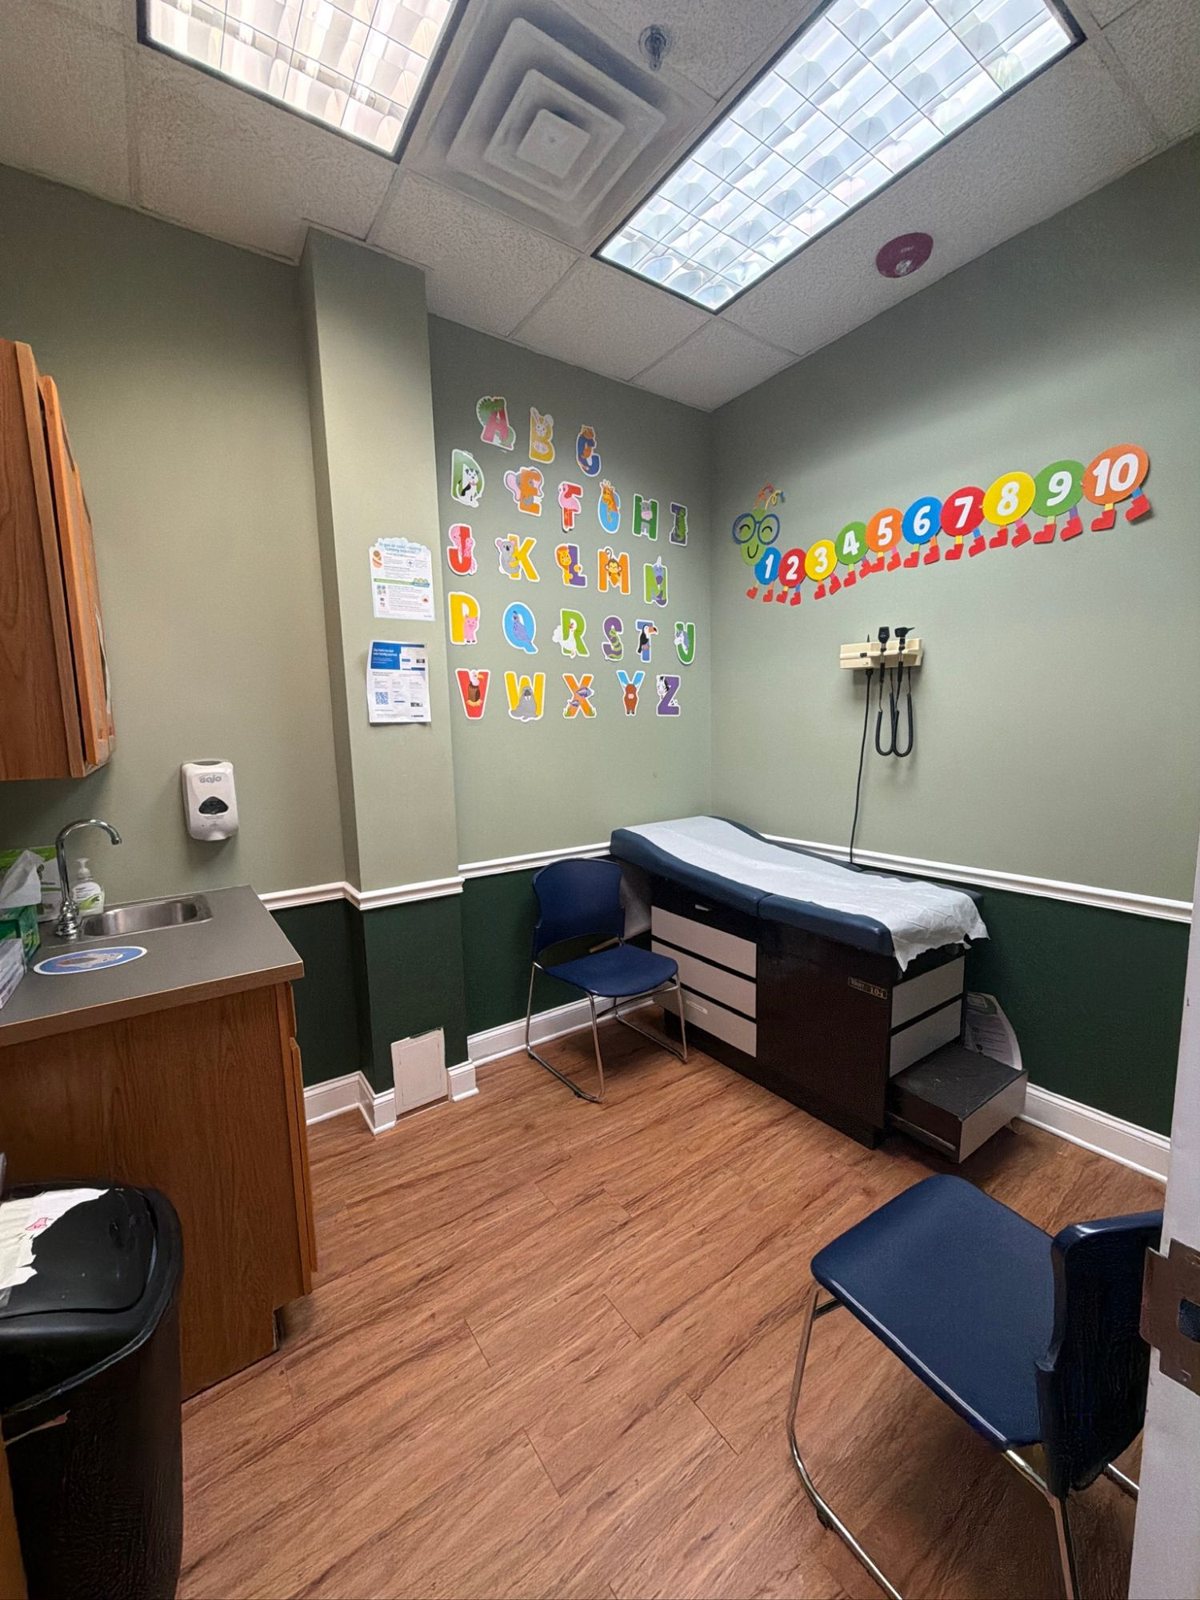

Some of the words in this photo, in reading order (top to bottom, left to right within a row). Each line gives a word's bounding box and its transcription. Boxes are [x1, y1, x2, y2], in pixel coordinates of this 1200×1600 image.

[478, 397, 515, 449] A
[530, 409, 555, 463] B
[576, 427, 601, 476] C
[451, 450, 485, 506] D
[514, 467, 544, 516] E
[559, 482, 583, 532] F
[598, 483, 620, 533] G
[633, 494, 659, 541] H
[670, 502, 688, 546] I
[765, 554, 774, 579] 1
[786, 555, 800, 580] 2
[814, 546, 829, 573] 3
[843, 530, 860, 556] 4
[877, 515, 894, 546] 5
[913, 505, 931, 536] 6
[954, 495, 974, 528] 7
[997, 481, 1020, 516] 8
[1046, 471, 1073, 506] 9
[1092, 453, 1139, 496] 10
[447, 524, 475, 575] J
[499, 534, 540, 582] K
[556, 544, 587, 587] L
[598, 548, 631, 595] M
[644, 560, 668, 607] N
[449, 592, 480, 645] P
[502, 602, 538, 654] Q
[556, 608, 590, 657] R
[602, 615, 624, 660] S
[635, 619, 657, 662] T
[674, 621, 695, 664] U
[455, 668, 490, 719] V
[504, 671, 545, 721] W
[562, 673, 596, 718] X
[616, 670, 645, 716] Y
[656, 674, 681, 717] Z
